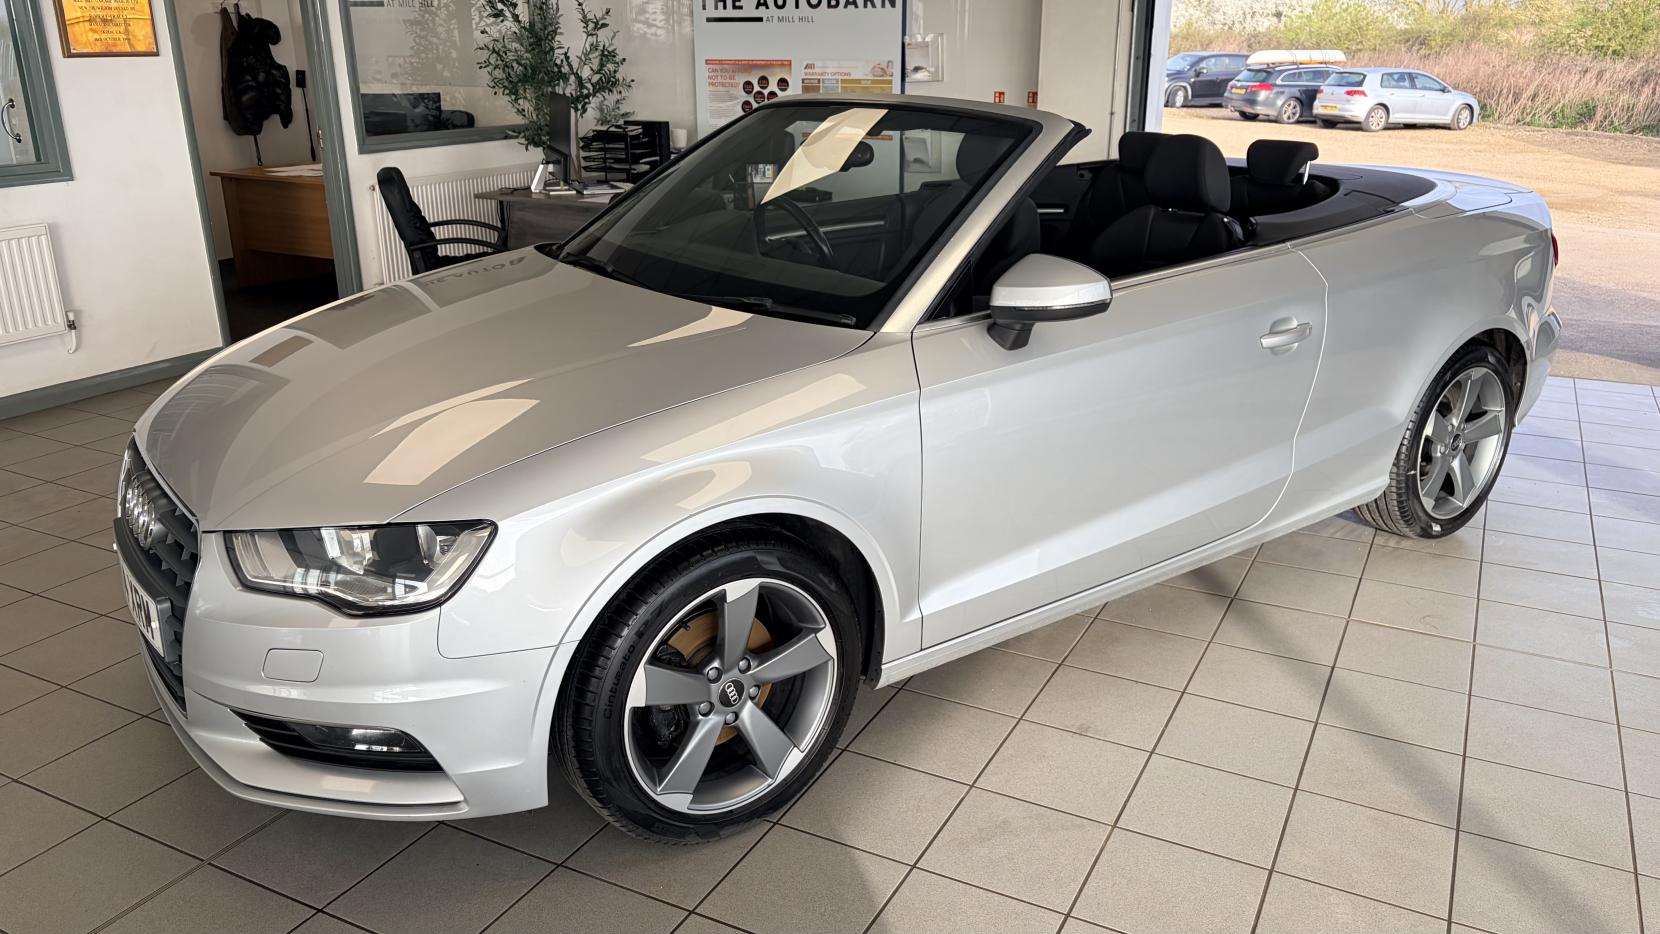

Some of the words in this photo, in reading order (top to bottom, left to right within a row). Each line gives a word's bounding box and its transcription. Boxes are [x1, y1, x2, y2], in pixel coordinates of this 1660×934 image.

[754, 0, 897, 10] AUTOBARN
[765, 15, 774, 23] AT
[777, 15, 796, 23] MILL
[798, 15, 815, 23] HILL
[603, 645, 635, 720] Cinturato
